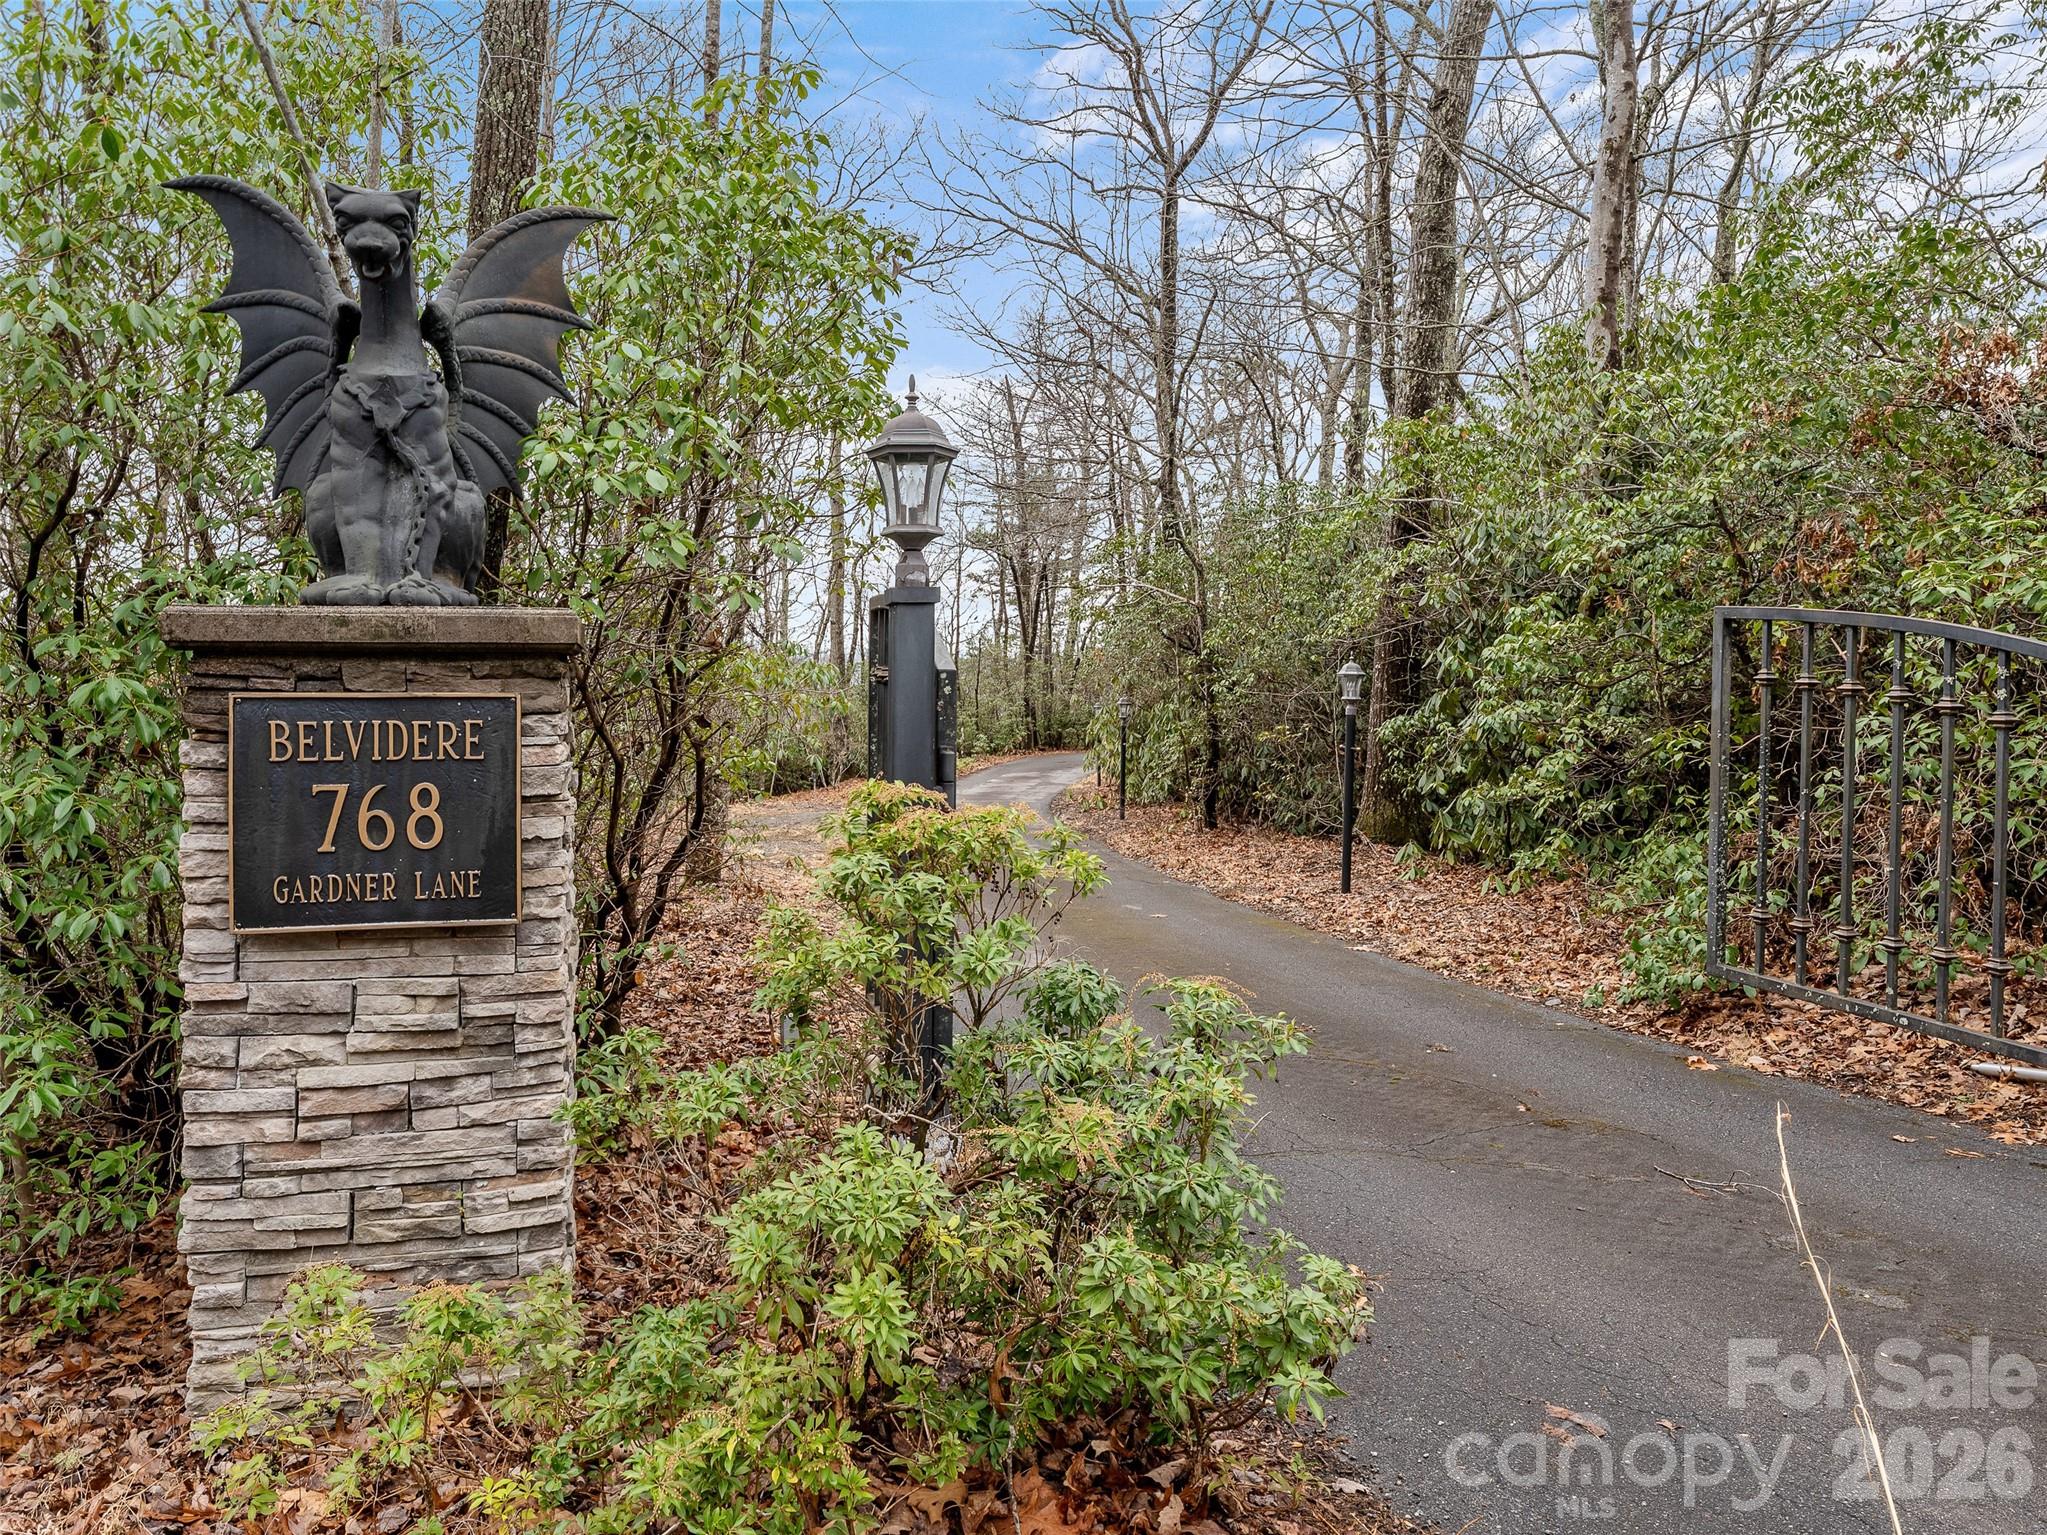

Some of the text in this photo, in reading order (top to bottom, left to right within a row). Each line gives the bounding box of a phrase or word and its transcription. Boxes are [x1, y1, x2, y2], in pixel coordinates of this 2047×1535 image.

[268, 720, 485, 762] BELVIDERE
[311, 782, 444, 853] 768
[273, 870, 482, 904] GARDNER LANE
